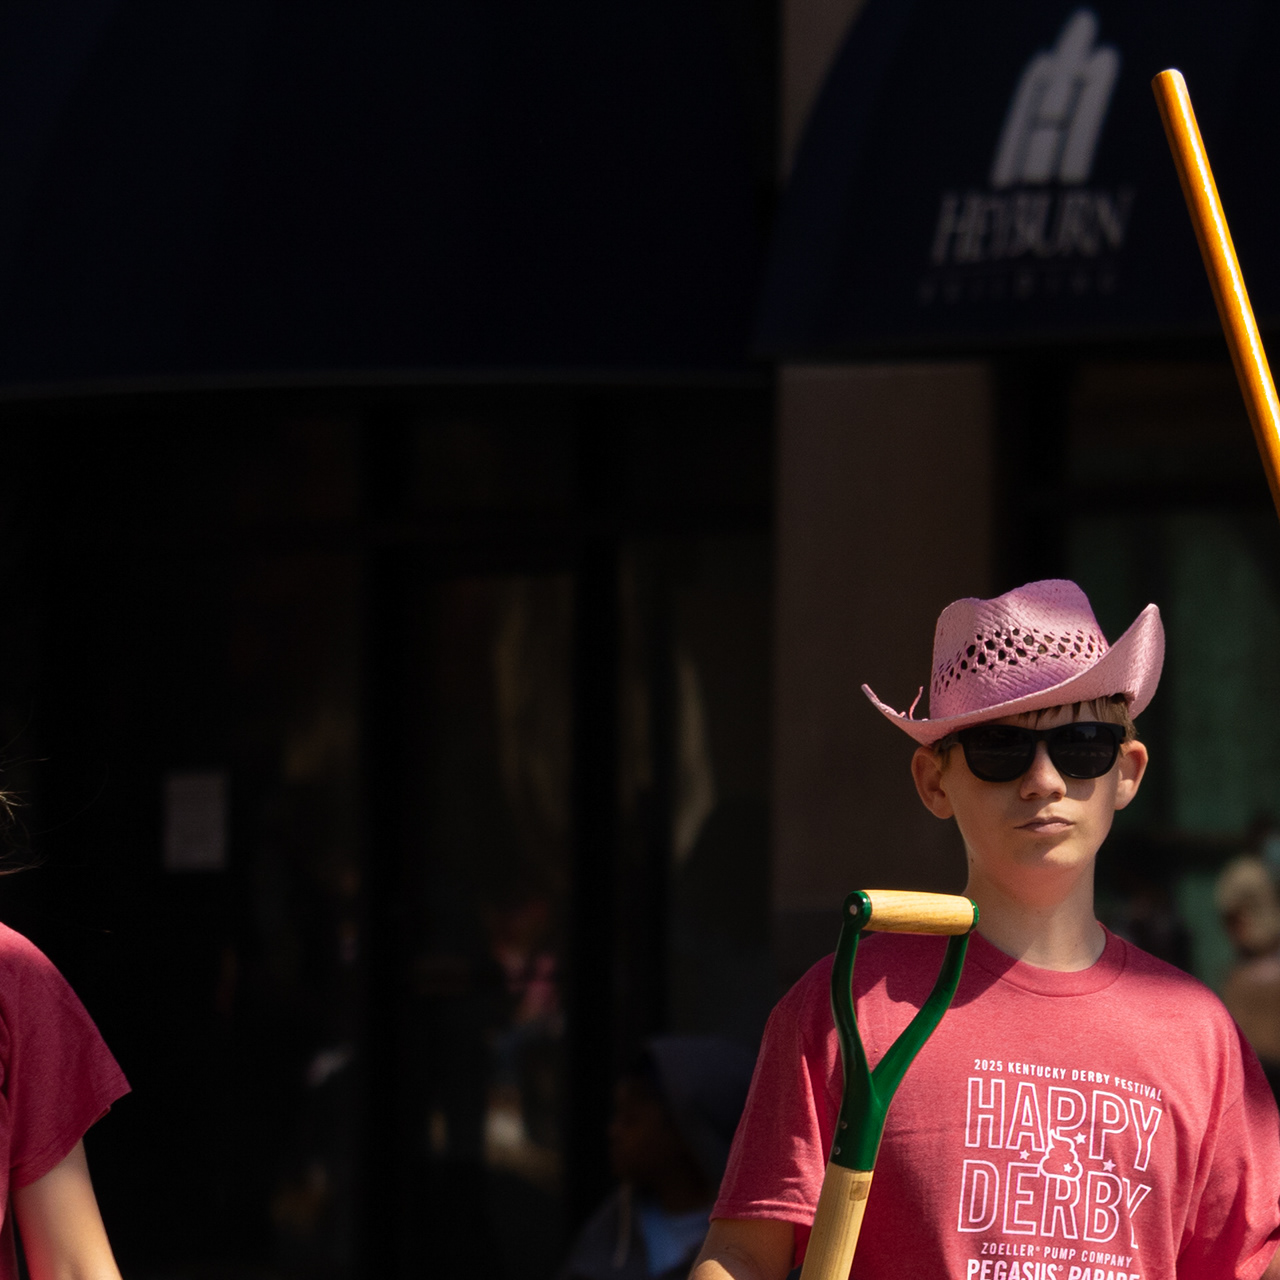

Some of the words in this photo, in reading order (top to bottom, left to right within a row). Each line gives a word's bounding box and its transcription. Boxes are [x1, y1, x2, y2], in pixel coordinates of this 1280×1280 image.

[974, 1058, 1004, 1072] 2025
[1007, 1062, 1067, 1080] KENTUCKY
[1071, 1069, 1110, 1085] DERBY
[1114, 1076, 1163, 1102] FESTIVAL
[965, 1077, 1162, 1172] HAPPY
[957, 1159, 1152, 1250] DERBY
[1043, 1246, 1077, 1260] PUMP
[1081, 1251, 1133, 1269] COMPANY
